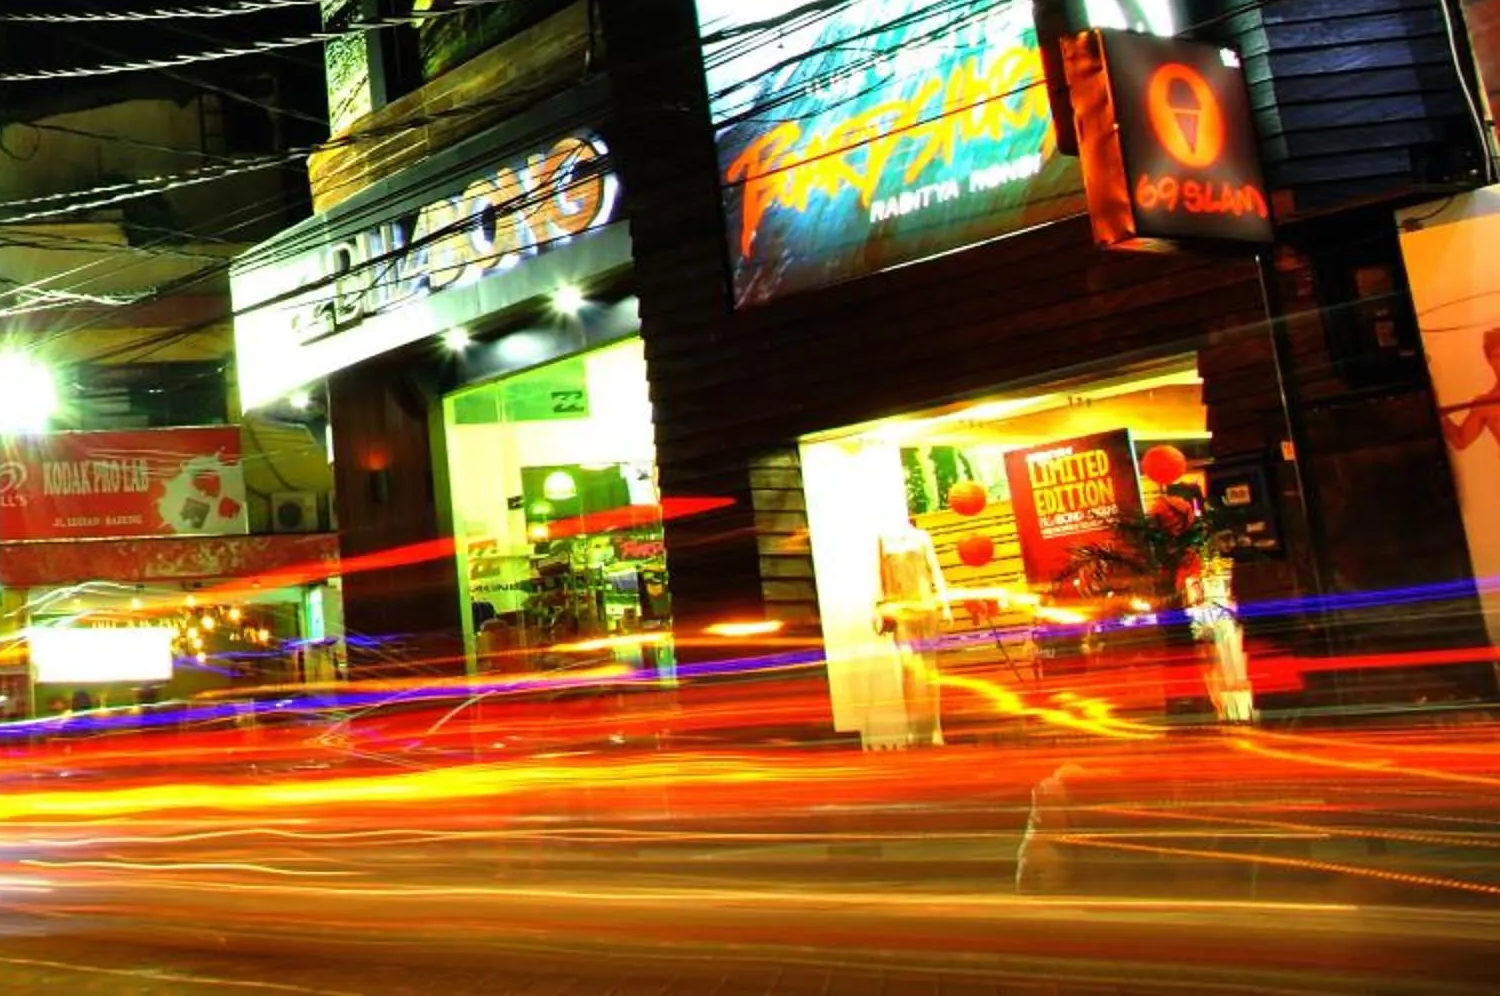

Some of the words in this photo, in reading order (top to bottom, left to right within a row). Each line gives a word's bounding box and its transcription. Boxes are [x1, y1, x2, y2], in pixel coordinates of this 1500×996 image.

[1136, 172, 1180, 211] 69
[1181, 180, 1270, 220] SLAM
[42, 460, 90, 496] KODAK
[92, 459, 121, 494] PRO
[122, 457, 152, 492] LAB
[1026, 448, 1110, 491] LIMITED
[1033, 477, 1116, 517] EDITION
